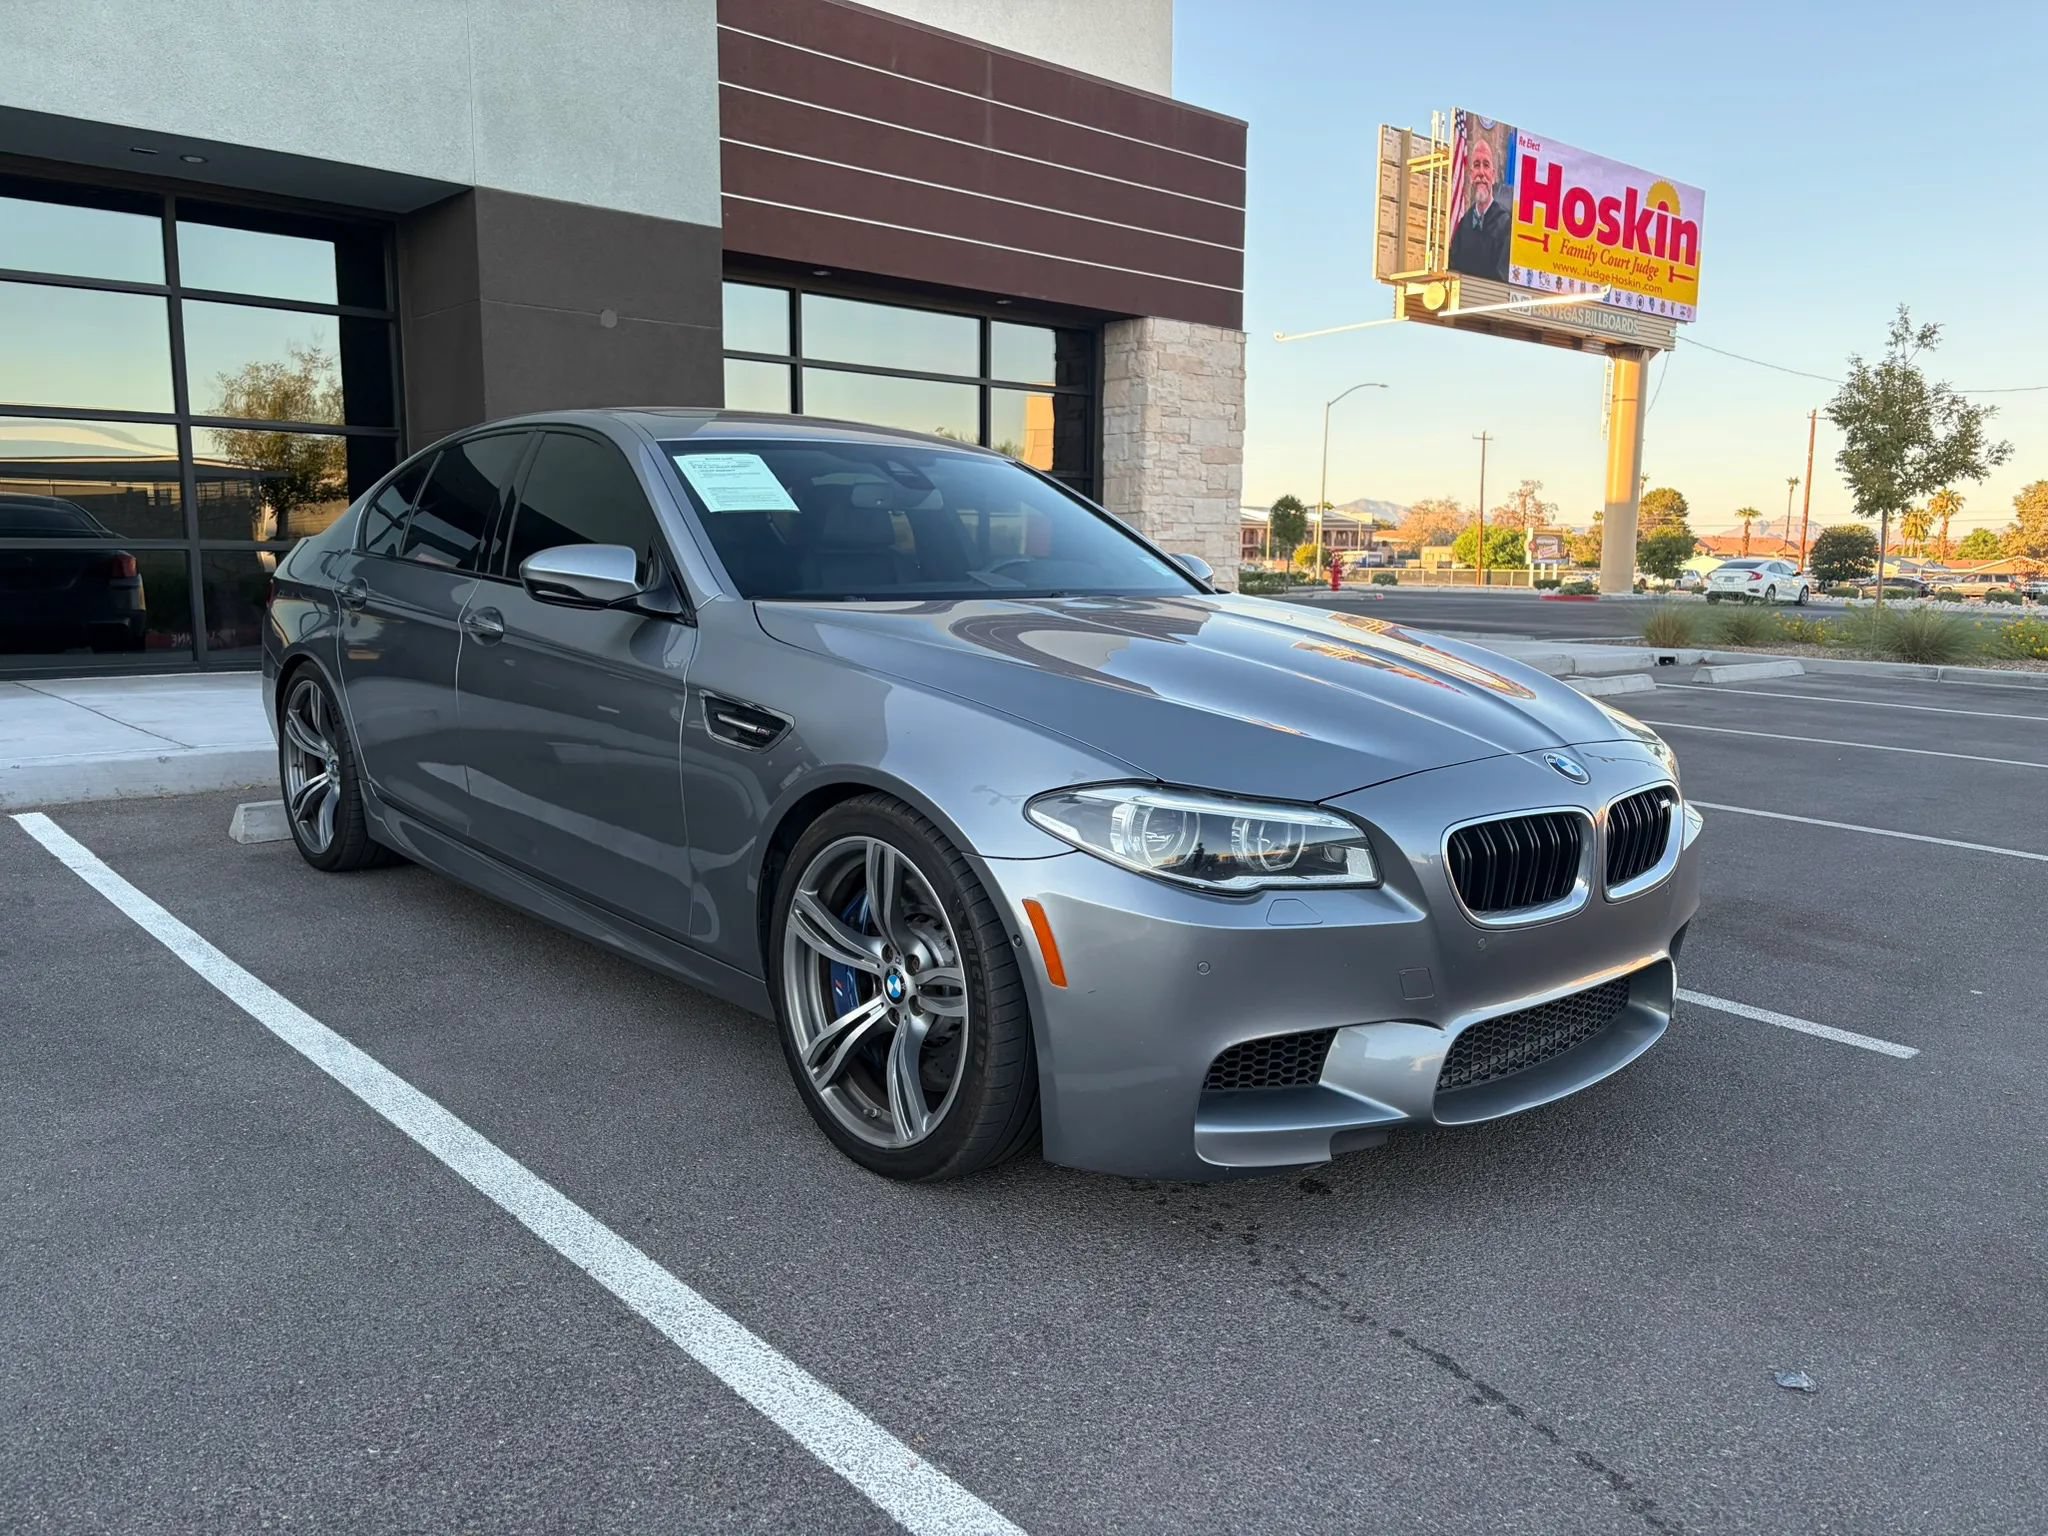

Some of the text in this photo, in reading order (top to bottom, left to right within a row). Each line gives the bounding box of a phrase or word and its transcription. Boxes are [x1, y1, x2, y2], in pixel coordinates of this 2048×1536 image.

[1527, 138, 1540, 151] Elect
[1518, 154, 1698, 267] Hoskin
[1560, 238, 1659, 281] Family Court Judge
[1532, 303, 1552, 317] LAS
[1553, 304, 1585, 323] VEGAS
[1585, 311, 1640, 334] BILLBOARDS
